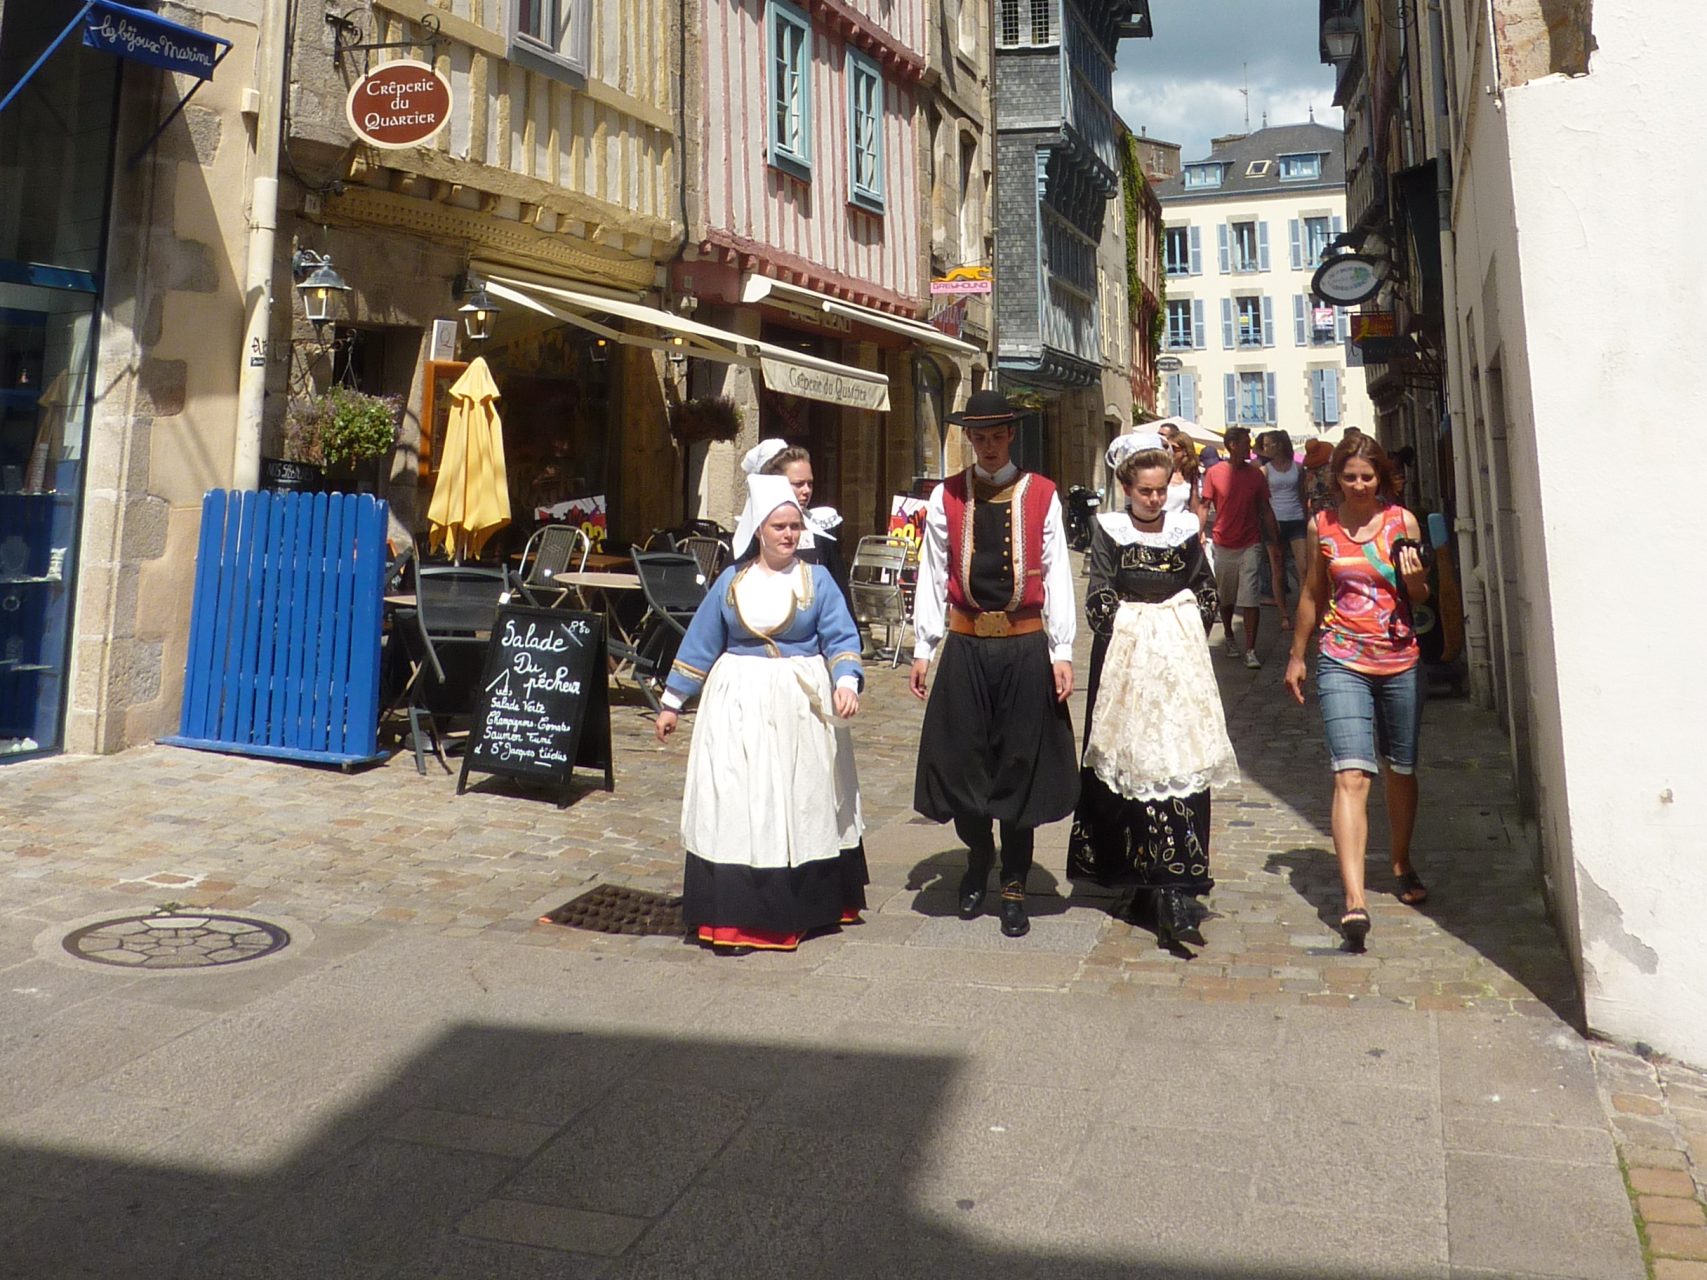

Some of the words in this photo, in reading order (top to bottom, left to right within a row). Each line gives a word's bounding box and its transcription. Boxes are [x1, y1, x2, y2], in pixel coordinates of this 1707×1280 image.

[366, 78, 435, 97] Crêperie
[390, 97, 410, 110] du
[364, 111, 435, 131] Quartier
[501, 619, 569, 652] Salade
[513, 652, 543, 674] Du
[490, 696, 521, 711] Salade
[483, 726, 524, 742] Saumon
